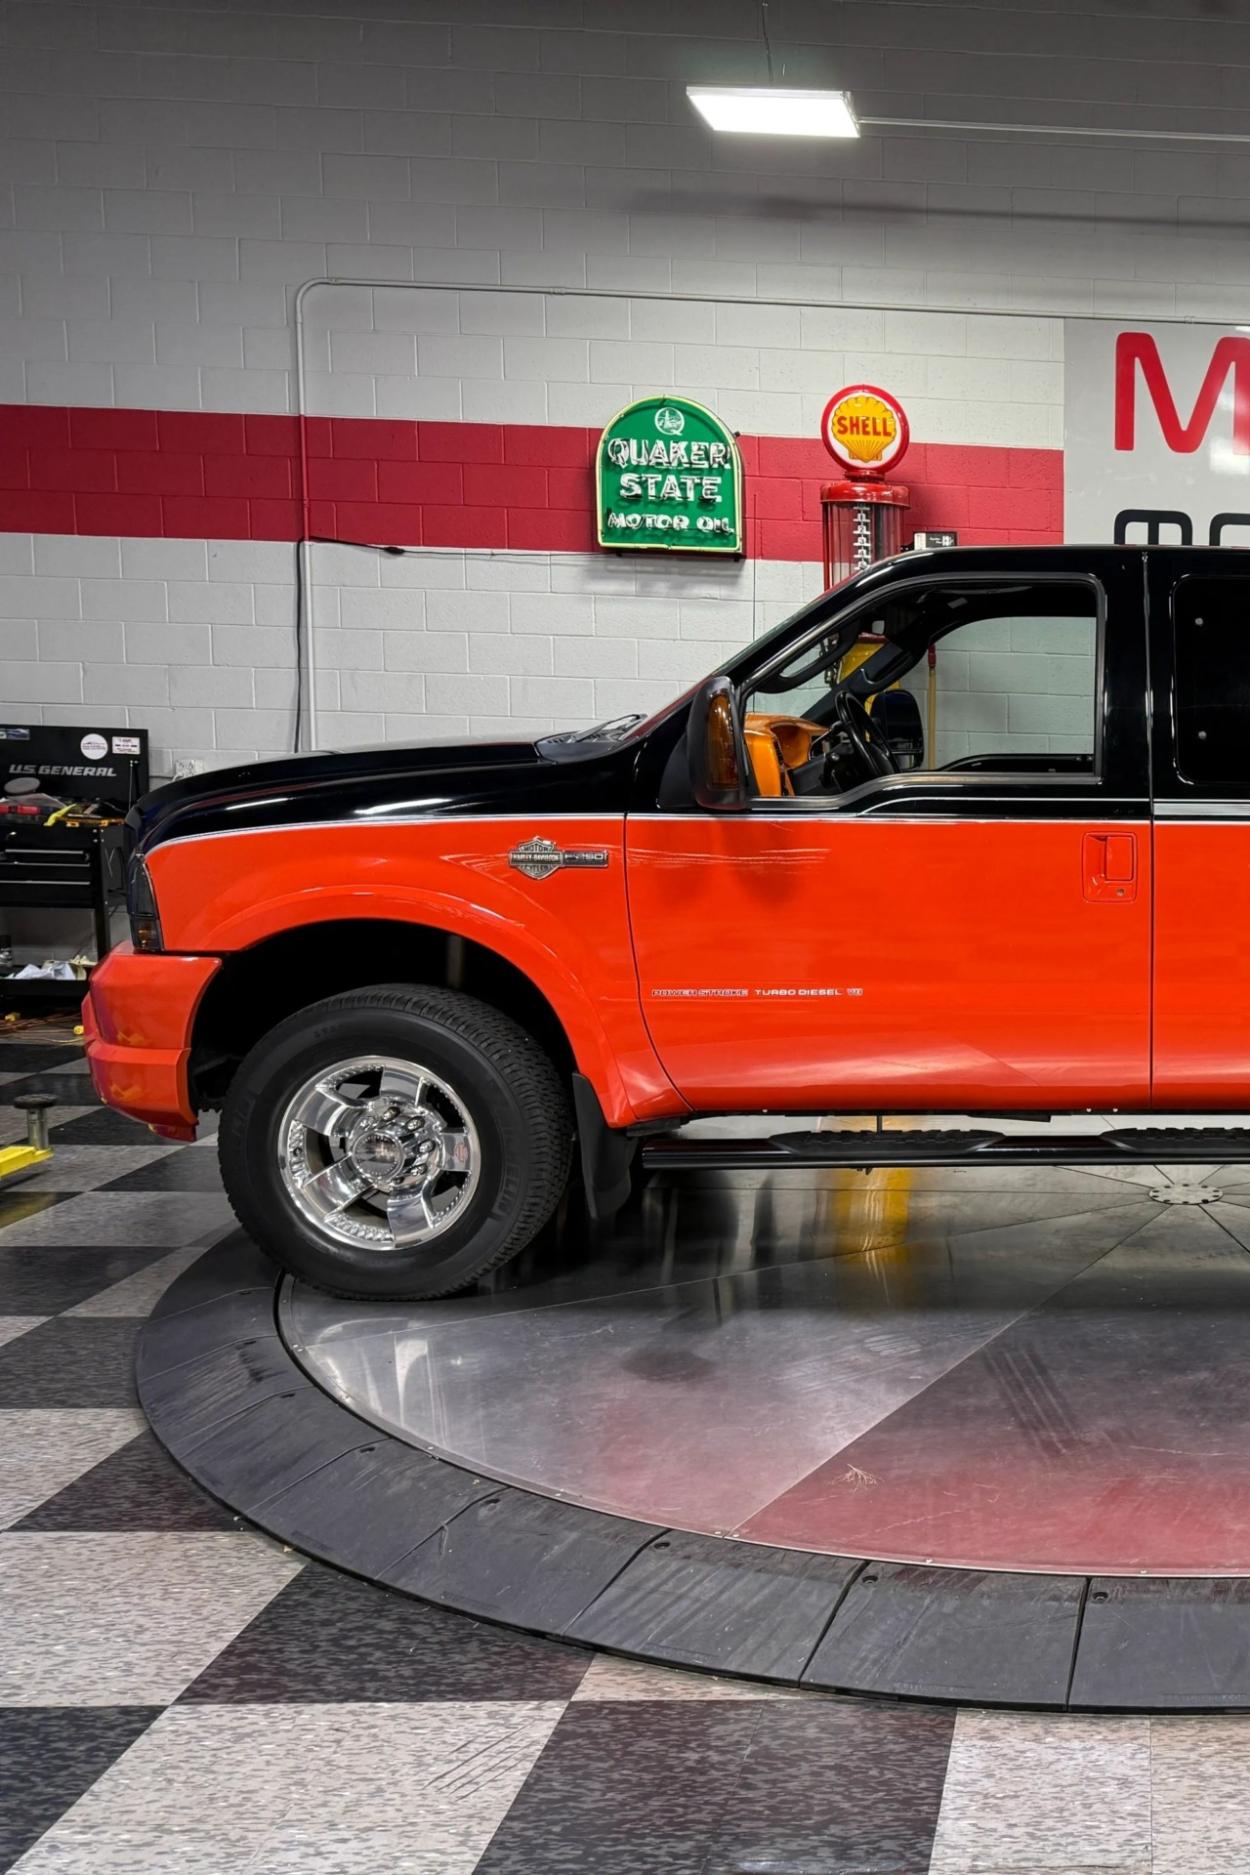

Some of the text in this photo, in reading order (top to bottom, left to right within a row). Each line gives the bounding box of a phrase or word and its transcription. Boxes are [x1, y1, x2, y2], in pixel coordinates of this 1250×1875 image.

[837, 416, 892, 437] SHELL
[607, 438, 731, 469] QUAKER
[619, 473, 722, 502] STATE
[608, 512, 735, 535] MOTOR OIL
[37, 765, 117, 777] GENERAL
[755, 988, 796, 996] TURBO
[798, 988, 842, 996] DIESEL
